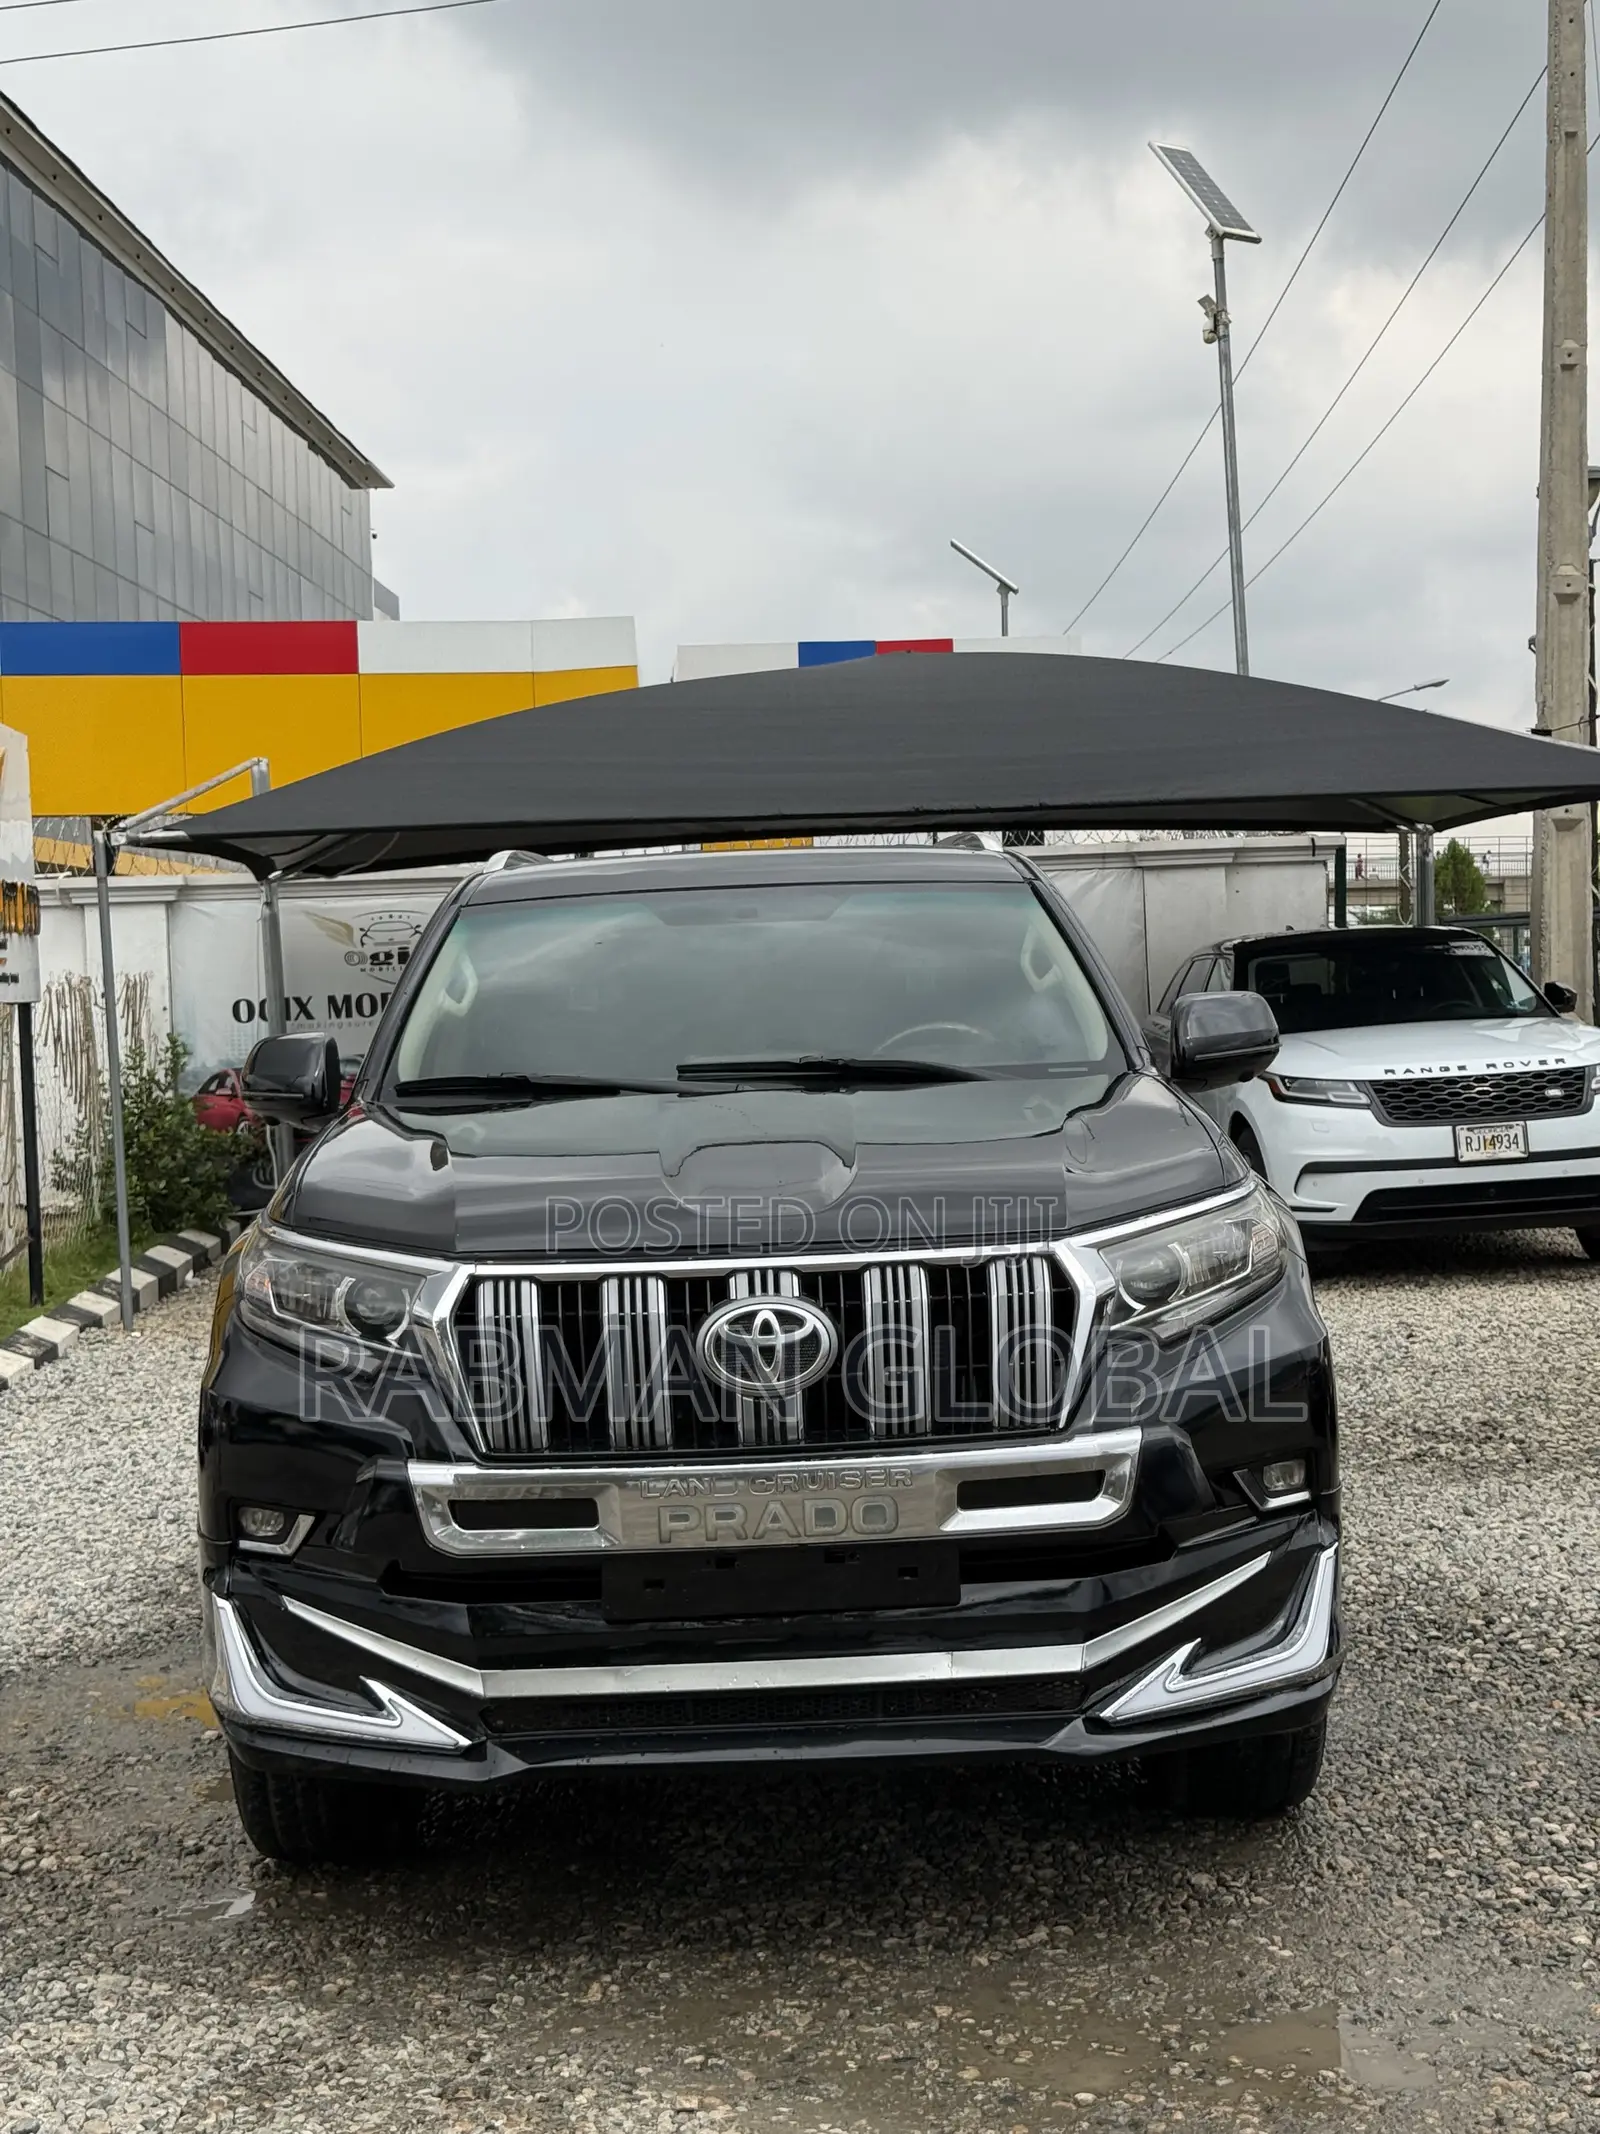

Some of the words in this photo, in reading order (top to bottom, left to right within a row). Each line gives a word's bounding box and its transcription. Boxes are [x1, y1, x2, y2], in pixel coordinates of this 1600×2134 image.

[1384, 1065, 1468, 1076] RANGE
[1485, 1057, 1567, 1070] ROVER
[640, 1477, 739, 1500] LAND
[750, 1468, 913, 1496] CRUISER
[658, 1494, 899, 1544] PRADO
